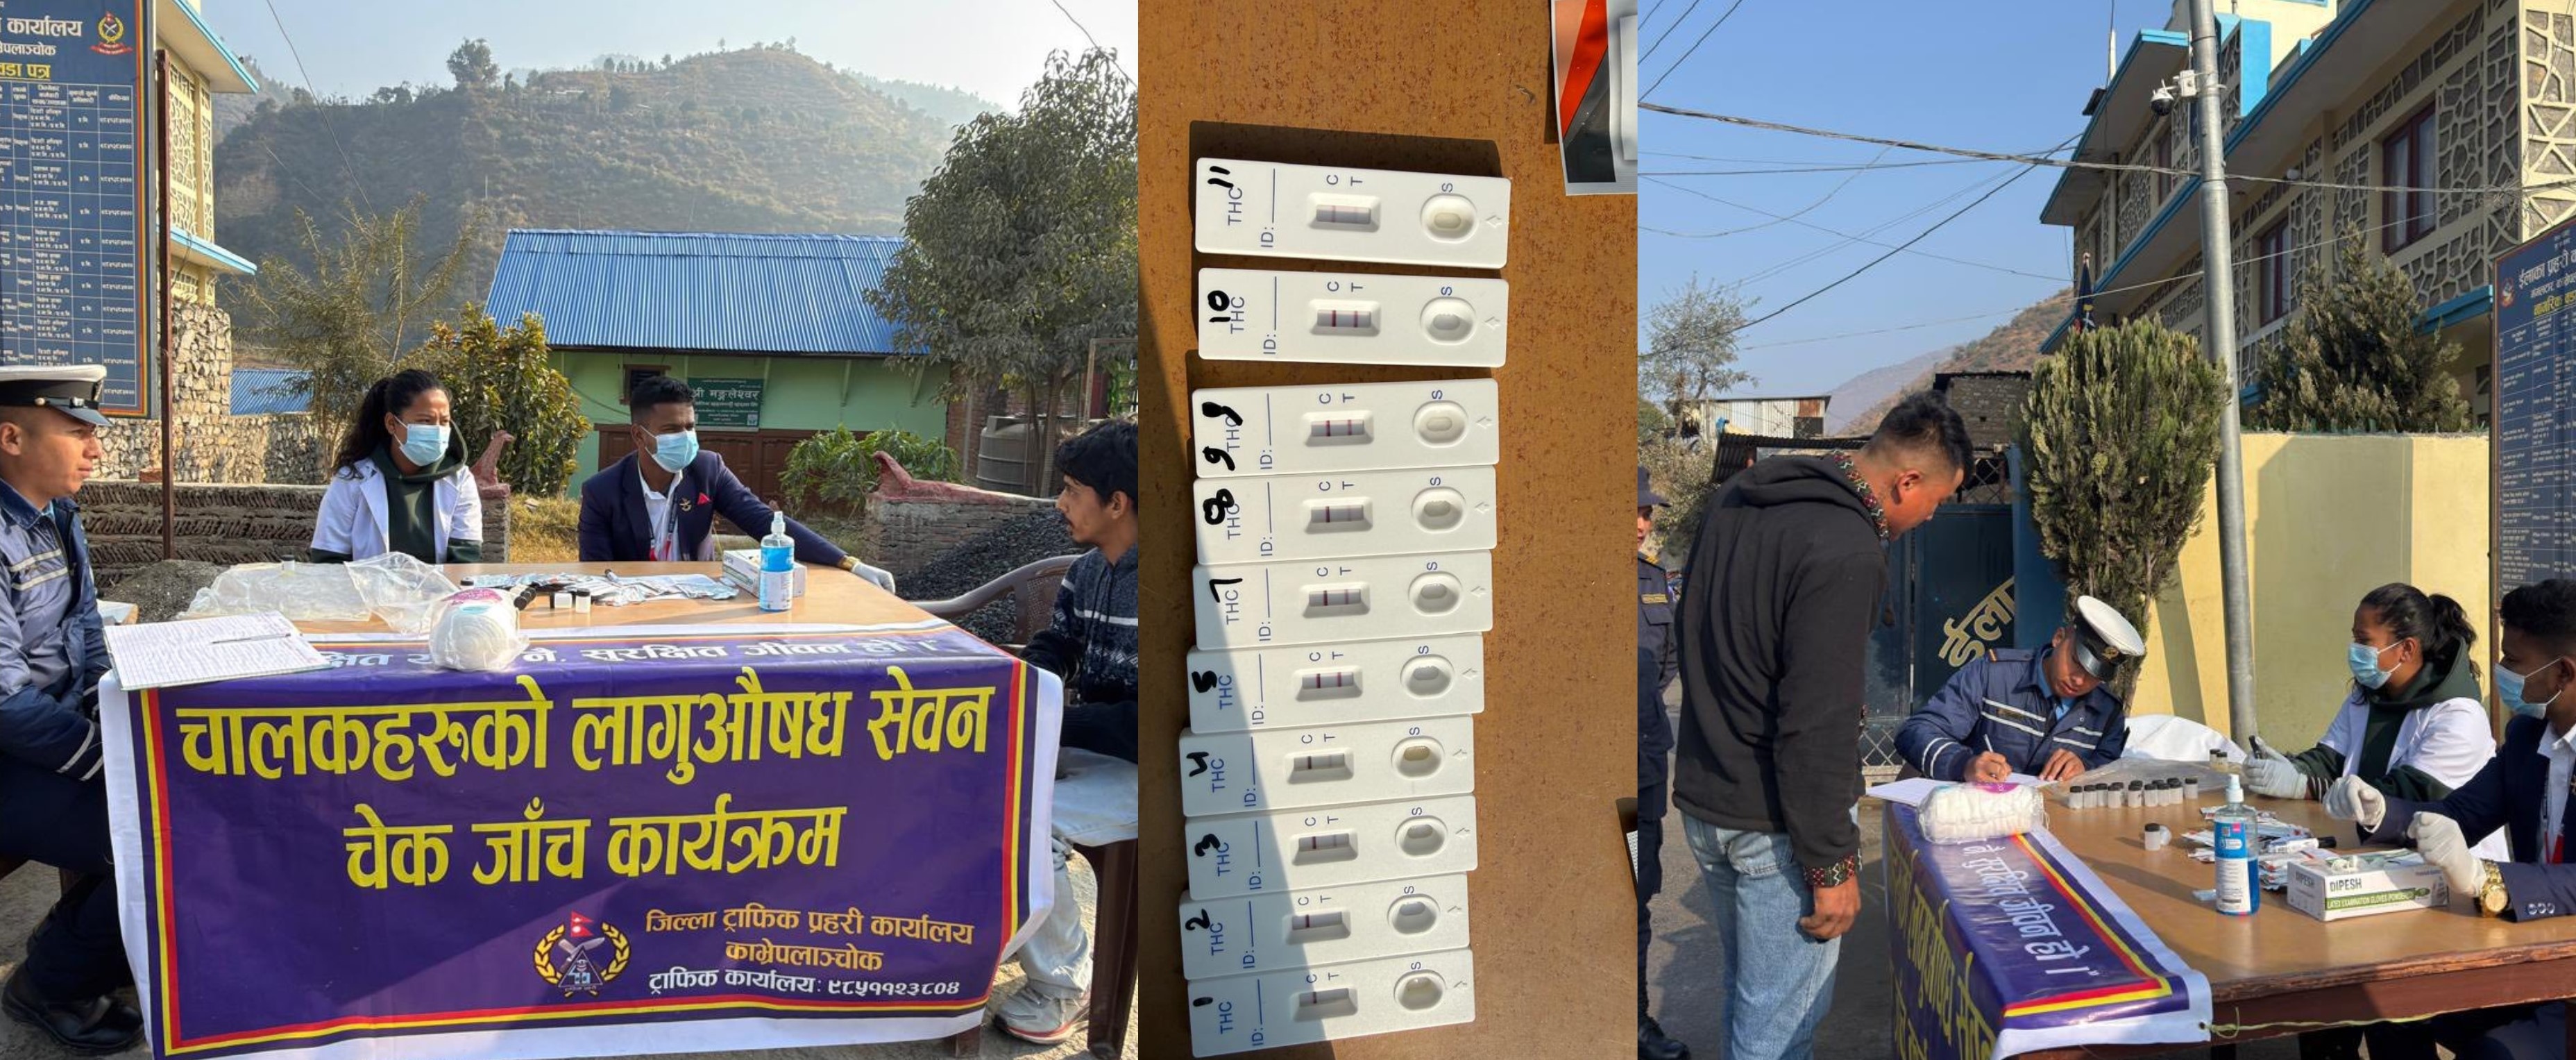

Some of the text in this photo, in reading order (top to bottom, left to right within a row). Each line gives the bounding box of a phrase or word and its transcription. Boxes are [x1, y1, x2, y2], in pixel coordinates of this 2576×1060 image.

[6, 15, 83, 37] कार्यालय
[26, 63, 51, 79] पत्र
[1326, 174, 1339, 185] C
[1350, 176, 1363, 187] T
[1441, 182, 1453, 193] S
[1327, 280, 1339, 292] C
[1350, 283, 1364, 293] T
[1441, 285, 1452, 296] S
[1208, 290, 1231, 323] 10
[1230, 296, 1245, 334] THC
[1319, 392, 1332, 404] C
[1342, 392, 1355, 403] T
[1431, 389, 1443, 400] S
[1319, 480, 1332, 491] C
[1342, 480, 1355, 490] T
[1430, 477, 1441, 487] S
[1203, 488, 1235, 525] 8
[1227, 503, 1242, 540] THC
[1316, 566, 1329, 578] C
[1339, 566, 1353, 575] T
[1427, 561, 1438, 571] S
[1209, 578, 1243, 603] 7
[1226, 589, 1239, 625] THC
[582, 643, 728, 662] सुरक्षित
[742, 640, 851, 656] जीवन
[1332, 650, 1344, 660] T
[1418, 645, 1430, 655] S
[1310, 651, 1321, 662] C
[1192, 670, 1218, 693] 5
[1218, 674, 1233, 710] THC
[570, 666, 853, 785] लागुऔषध
[867, 666, 996, 761] सेवन
[1409, 726, 1421, 736] S
[1301, 733, 1313, 745] C
[1324, 732, 1336, 743] T
[1186, 752, 1209, 777] 4
[1211, 758, 1226, 793] THC
[1412, 807, 1423, 816] S
[1305, 816, 1316, 827] C
[1327, 815, 1339, 825] T
[344, 793, 847, 889] चेक जाँच कार्यक्रम
[1194, 833, 1221, 857] 3
[1217, 841, 1230, 877] THC
[1404, 885, 1415, 895] S
[2329, 878, 2362, 892] DIPESH
[1298, 895, 1310, 907] C
[1320, 895, 1332, 904] T
[645, 902, 975, 945] जिल्ला ट्राफिक प्रहरी कार्यालय
[1185, 909, 1210, 931] 2
[1999, 897, 2063, 939] जीवन
[1211, 921, 1224, 956] THC
[725, 937, 885, 972] काभ्रेपलाञ्चोक
[1410, 961, 1422, 970] S
[649, 966, 720, 995] ट्राफिक
[827, 980, 961, 996] ९८५११२३८०४
[1306, 973, 1318, 984] C
[1328, 973, 1340, 981] T
[1219, 1000, 1233, 1035] THC
